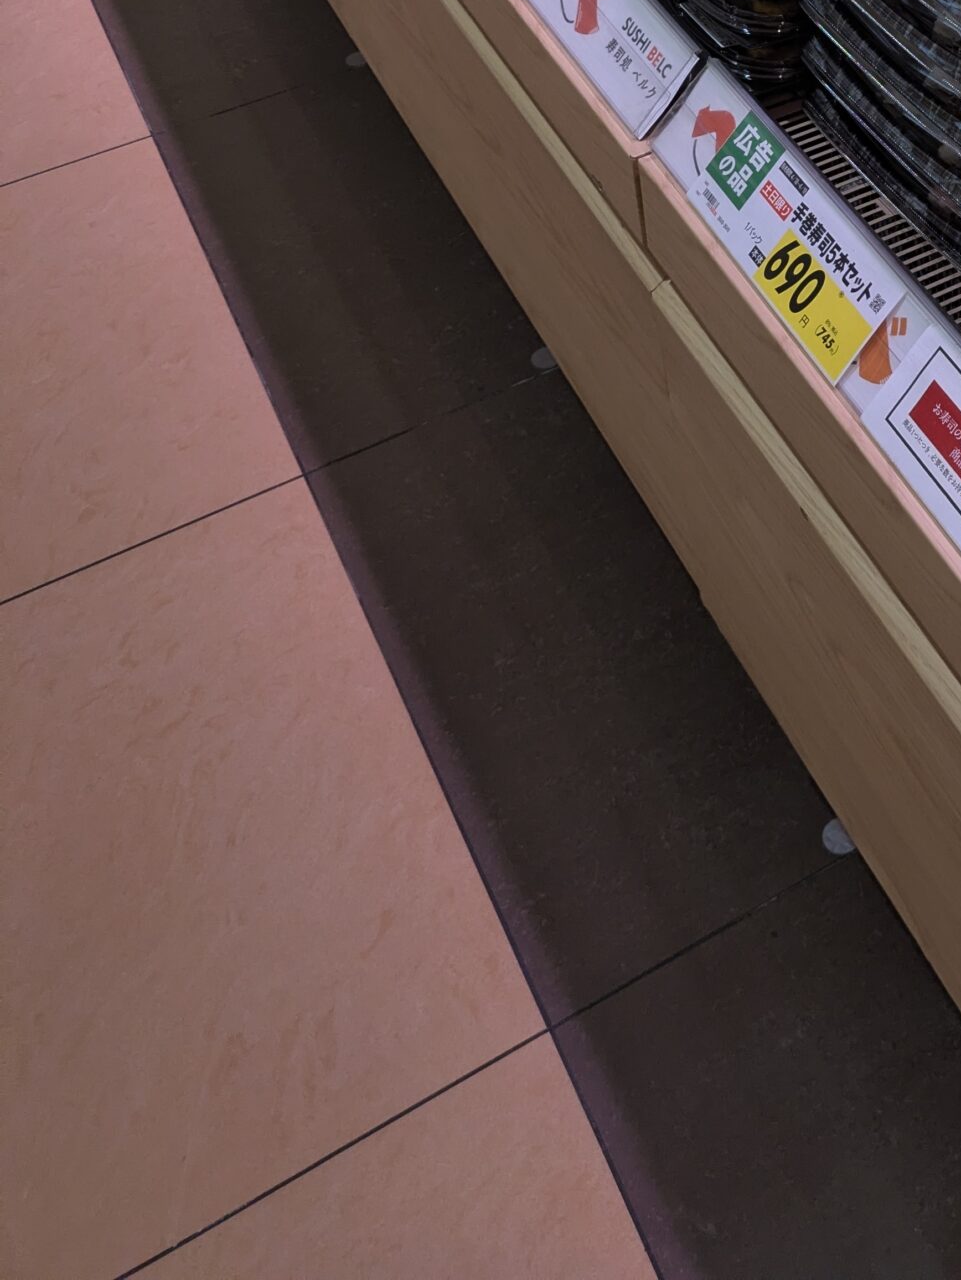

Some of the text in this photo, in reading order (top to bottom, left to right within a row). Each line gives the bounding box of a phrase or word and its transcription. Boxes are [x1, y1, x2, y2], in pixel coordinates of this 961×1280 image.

[605, 37, 657, 99] 寿司処 ベルク
[622, 16, 673, 79] SUSHI BELC
[733, 123, 774, 172] 広告
[718, 155, 753, 197] の品
[760, 183, 792, 218] 土日限り
[744, 222, 763, 245] 1パック
[791, 202, 872, 302] 手巻寿司5本セット
[763, 240, 827, 314] 690
[798, 314, 810, 329] 円
